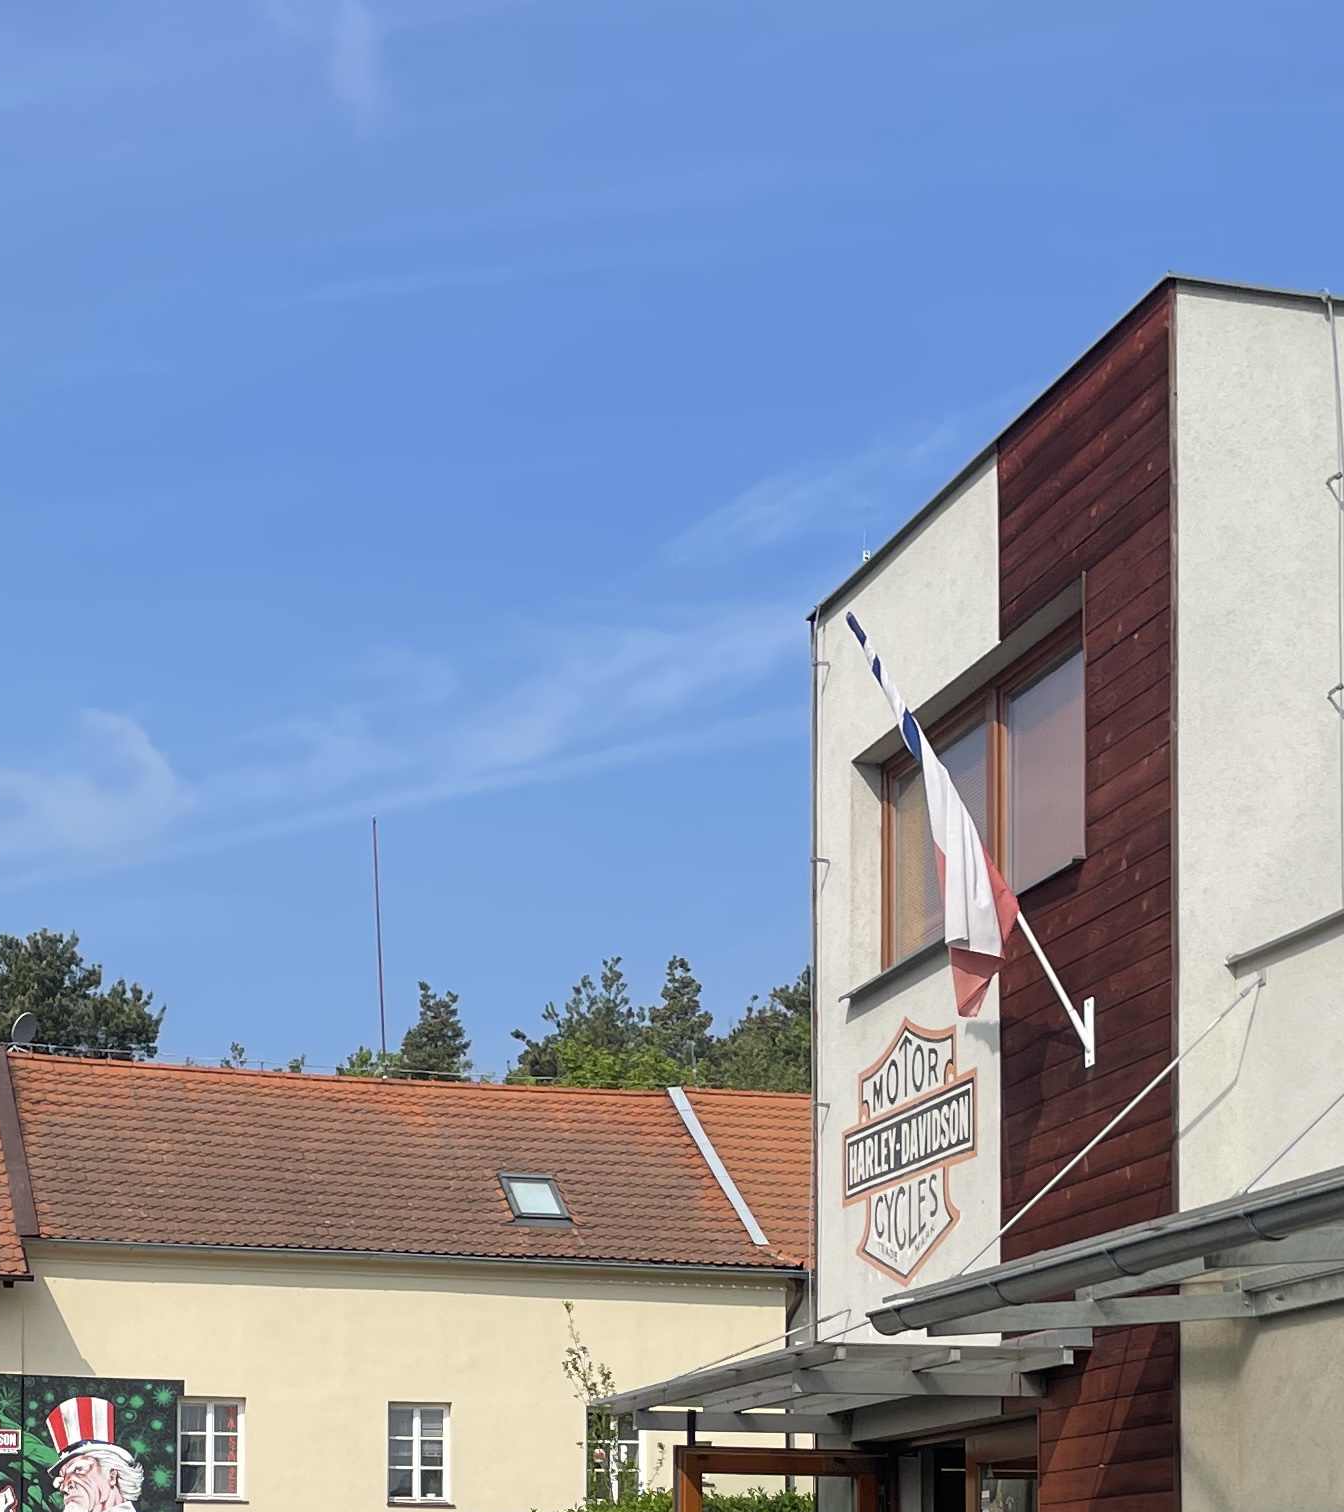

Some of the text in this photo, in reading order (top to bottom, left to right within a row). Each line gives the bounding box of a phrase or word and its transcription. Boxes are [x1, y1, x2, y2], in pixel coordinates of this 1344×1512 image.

[872, 1035, 939, 1113] MOTOR
[848, 1094, 970, 1185] HARLEY-DAVIDSON
[874, 1173, 938, 1251] CYCLES
[875, 1226, 936, 1263] TRADE MARK
